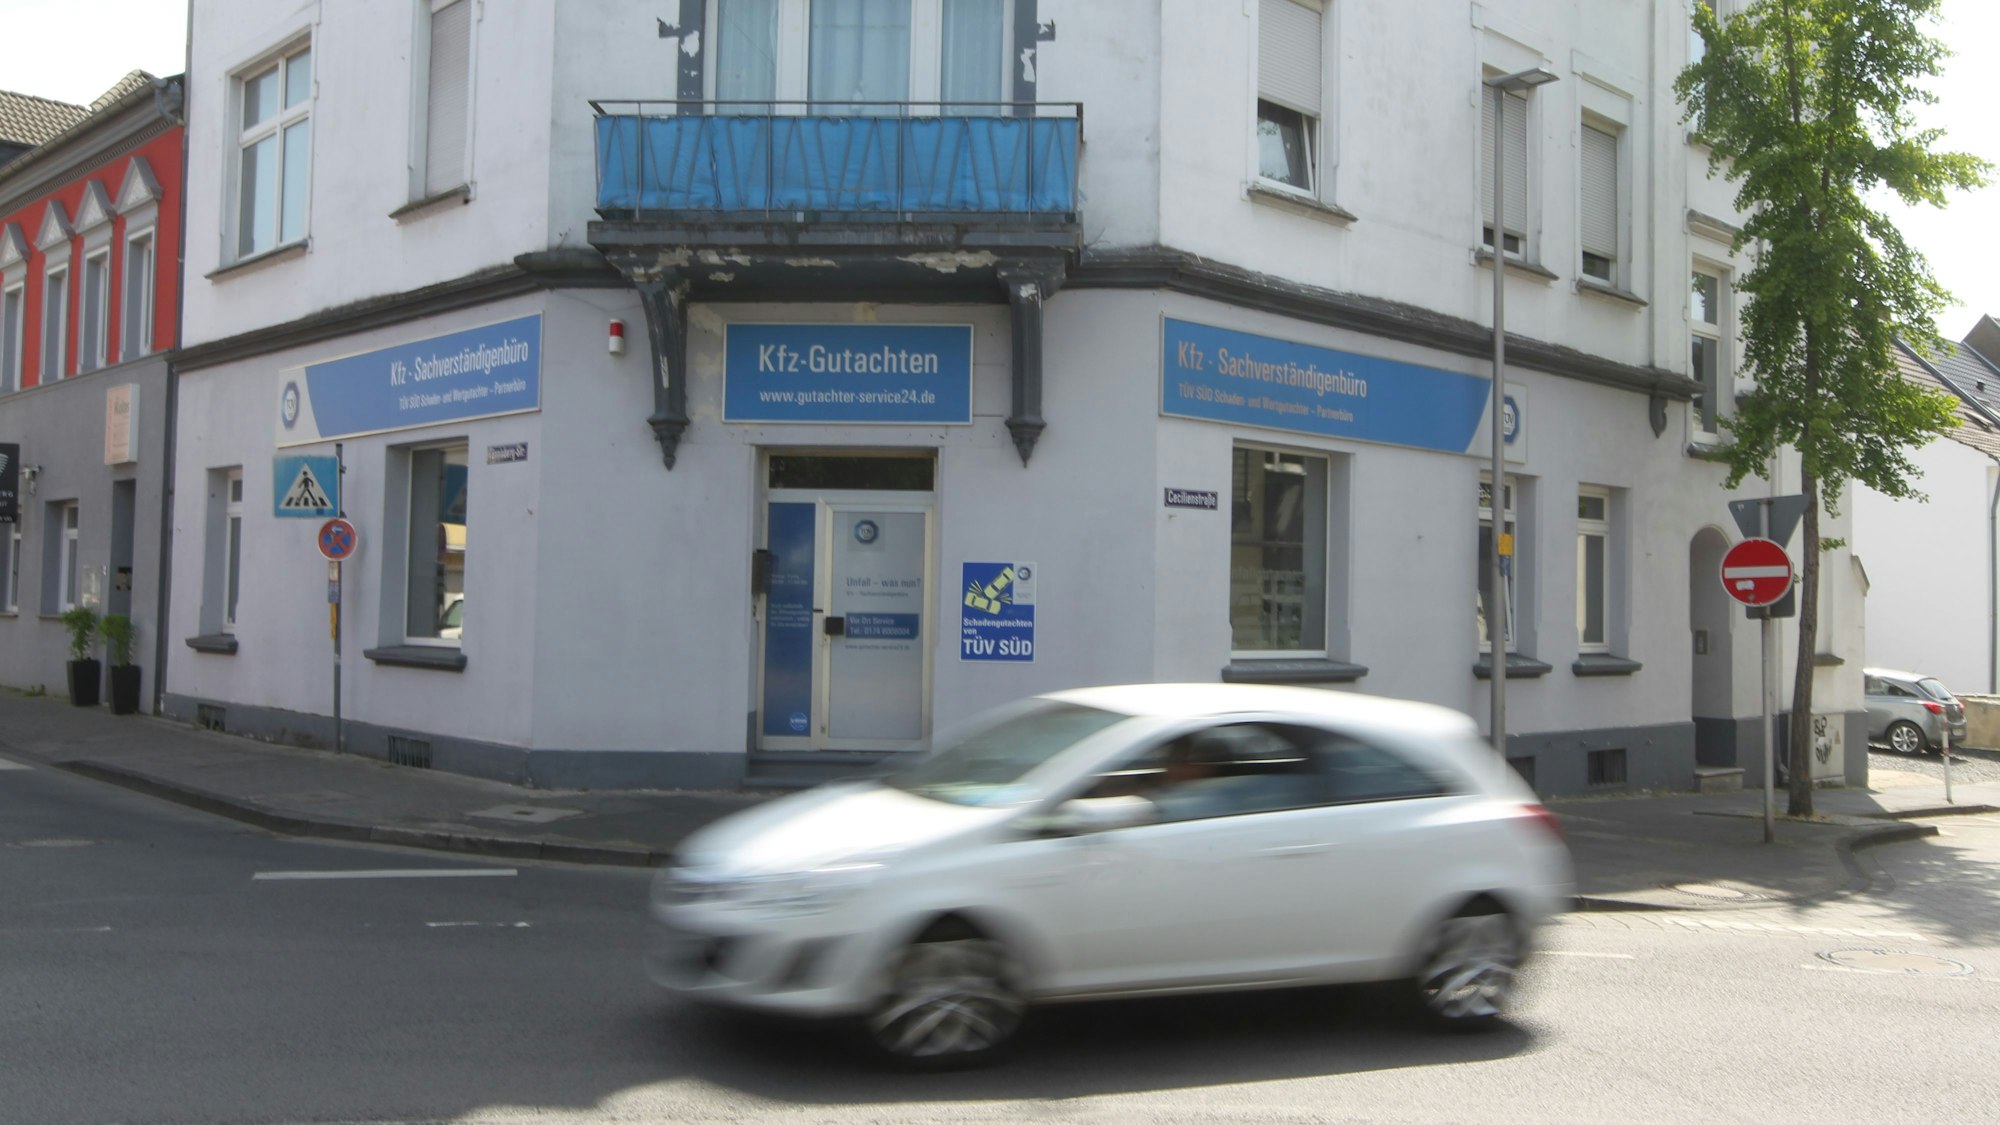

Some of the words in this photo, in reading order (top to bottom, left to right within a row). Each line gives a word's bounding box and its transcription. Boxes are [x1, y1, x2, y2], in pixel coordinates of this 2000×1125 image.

[391, 361, 406, 387] Kfz
[414, 338, 529, 383] Sachverständigenbüro
[759, 344, 939, 374] Kfz-Gutachten
[1177, 340, 1204, 371] Kfz
[1217, 347, 1368, 398] Sachverständigenbüro
[494, 377, 527, 396] Partnerbüro
[759, 388, 936, 406] www.gutachter-service24.de
[1178, 381, 1195, 399] TÜV
[1196, 384, 1214, 401] SÜD
[1317, 404, 1354, 423] Partnerbüro
[1168, 489, 1216, 508] Cecilienstraße
[846, 577, 871, 588] Unfall
[881, 579, 899, 588] was
[963, 617, 1033, 629] Schadengutachten
[963, 636, 995, 655] TÜV
[999, 636, 1033, 656] SÜD
